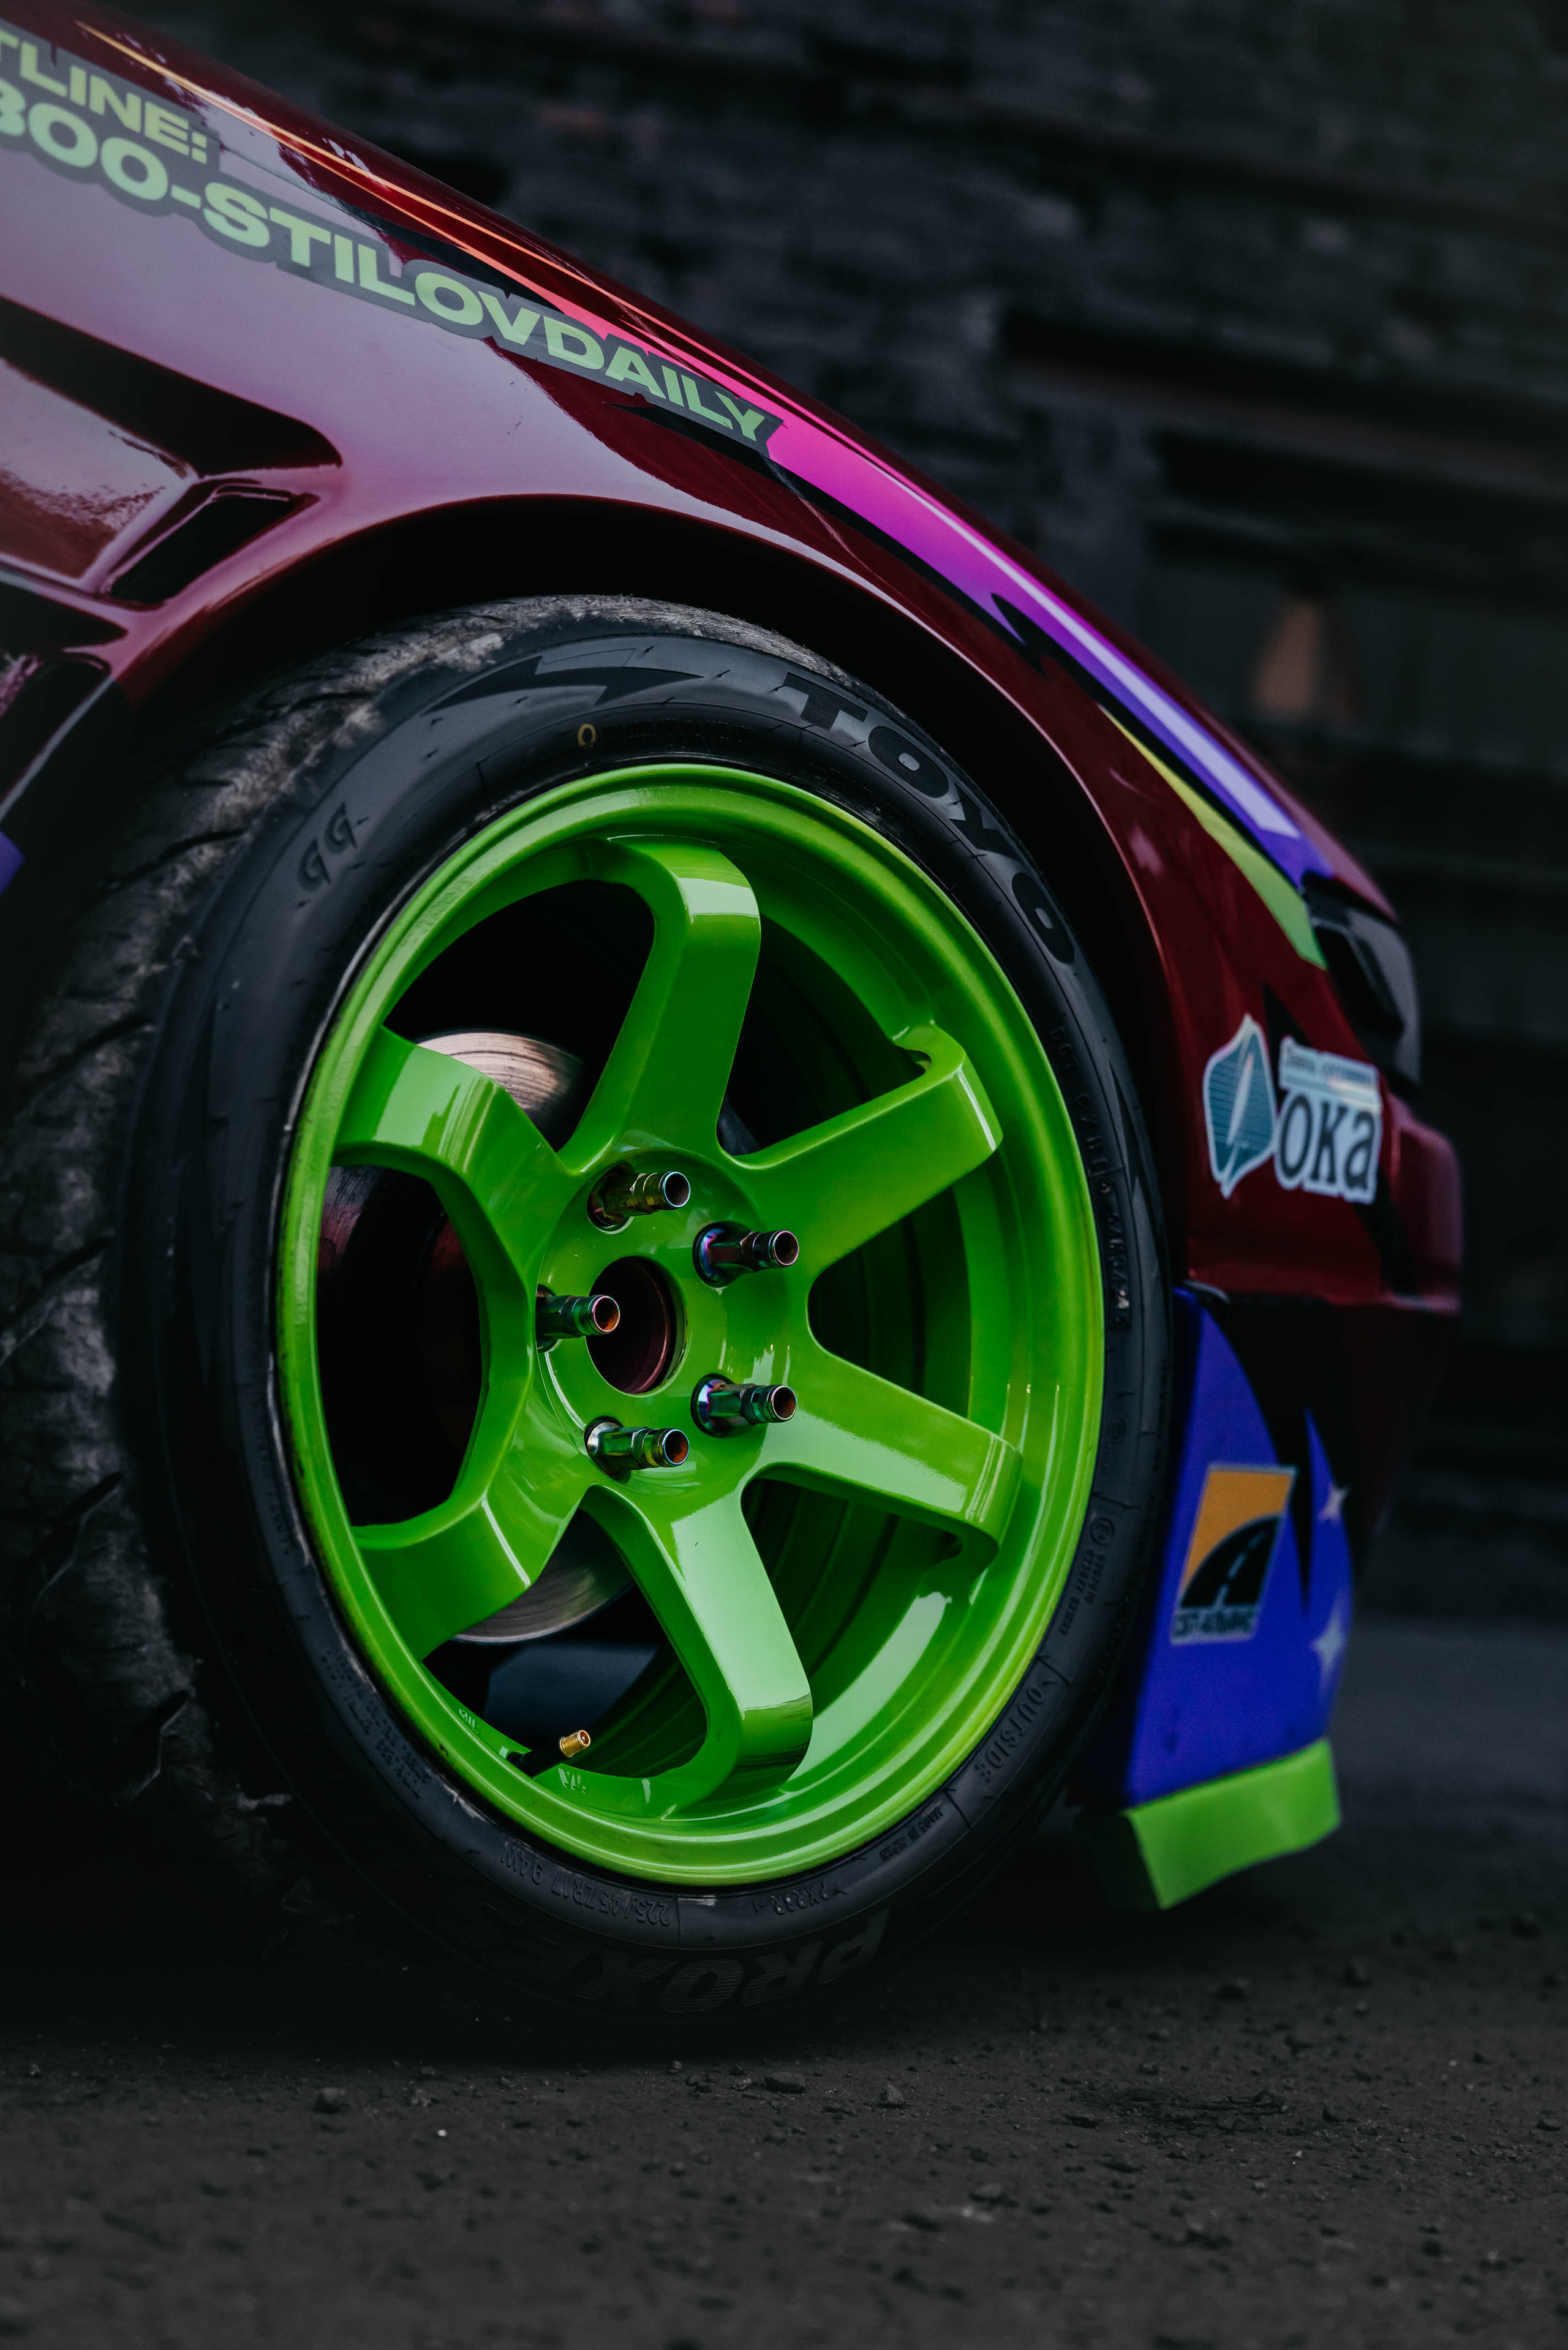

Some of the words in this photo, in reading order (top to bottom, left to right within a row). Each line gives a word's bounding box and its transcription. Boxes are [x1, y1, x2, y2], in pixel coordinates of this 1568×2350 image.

[783, 672, 1074, 963] TOYO
[974, 1688, 1046, 1783] OUTSIDE
[500, 1841, 544, 1885] 94W
